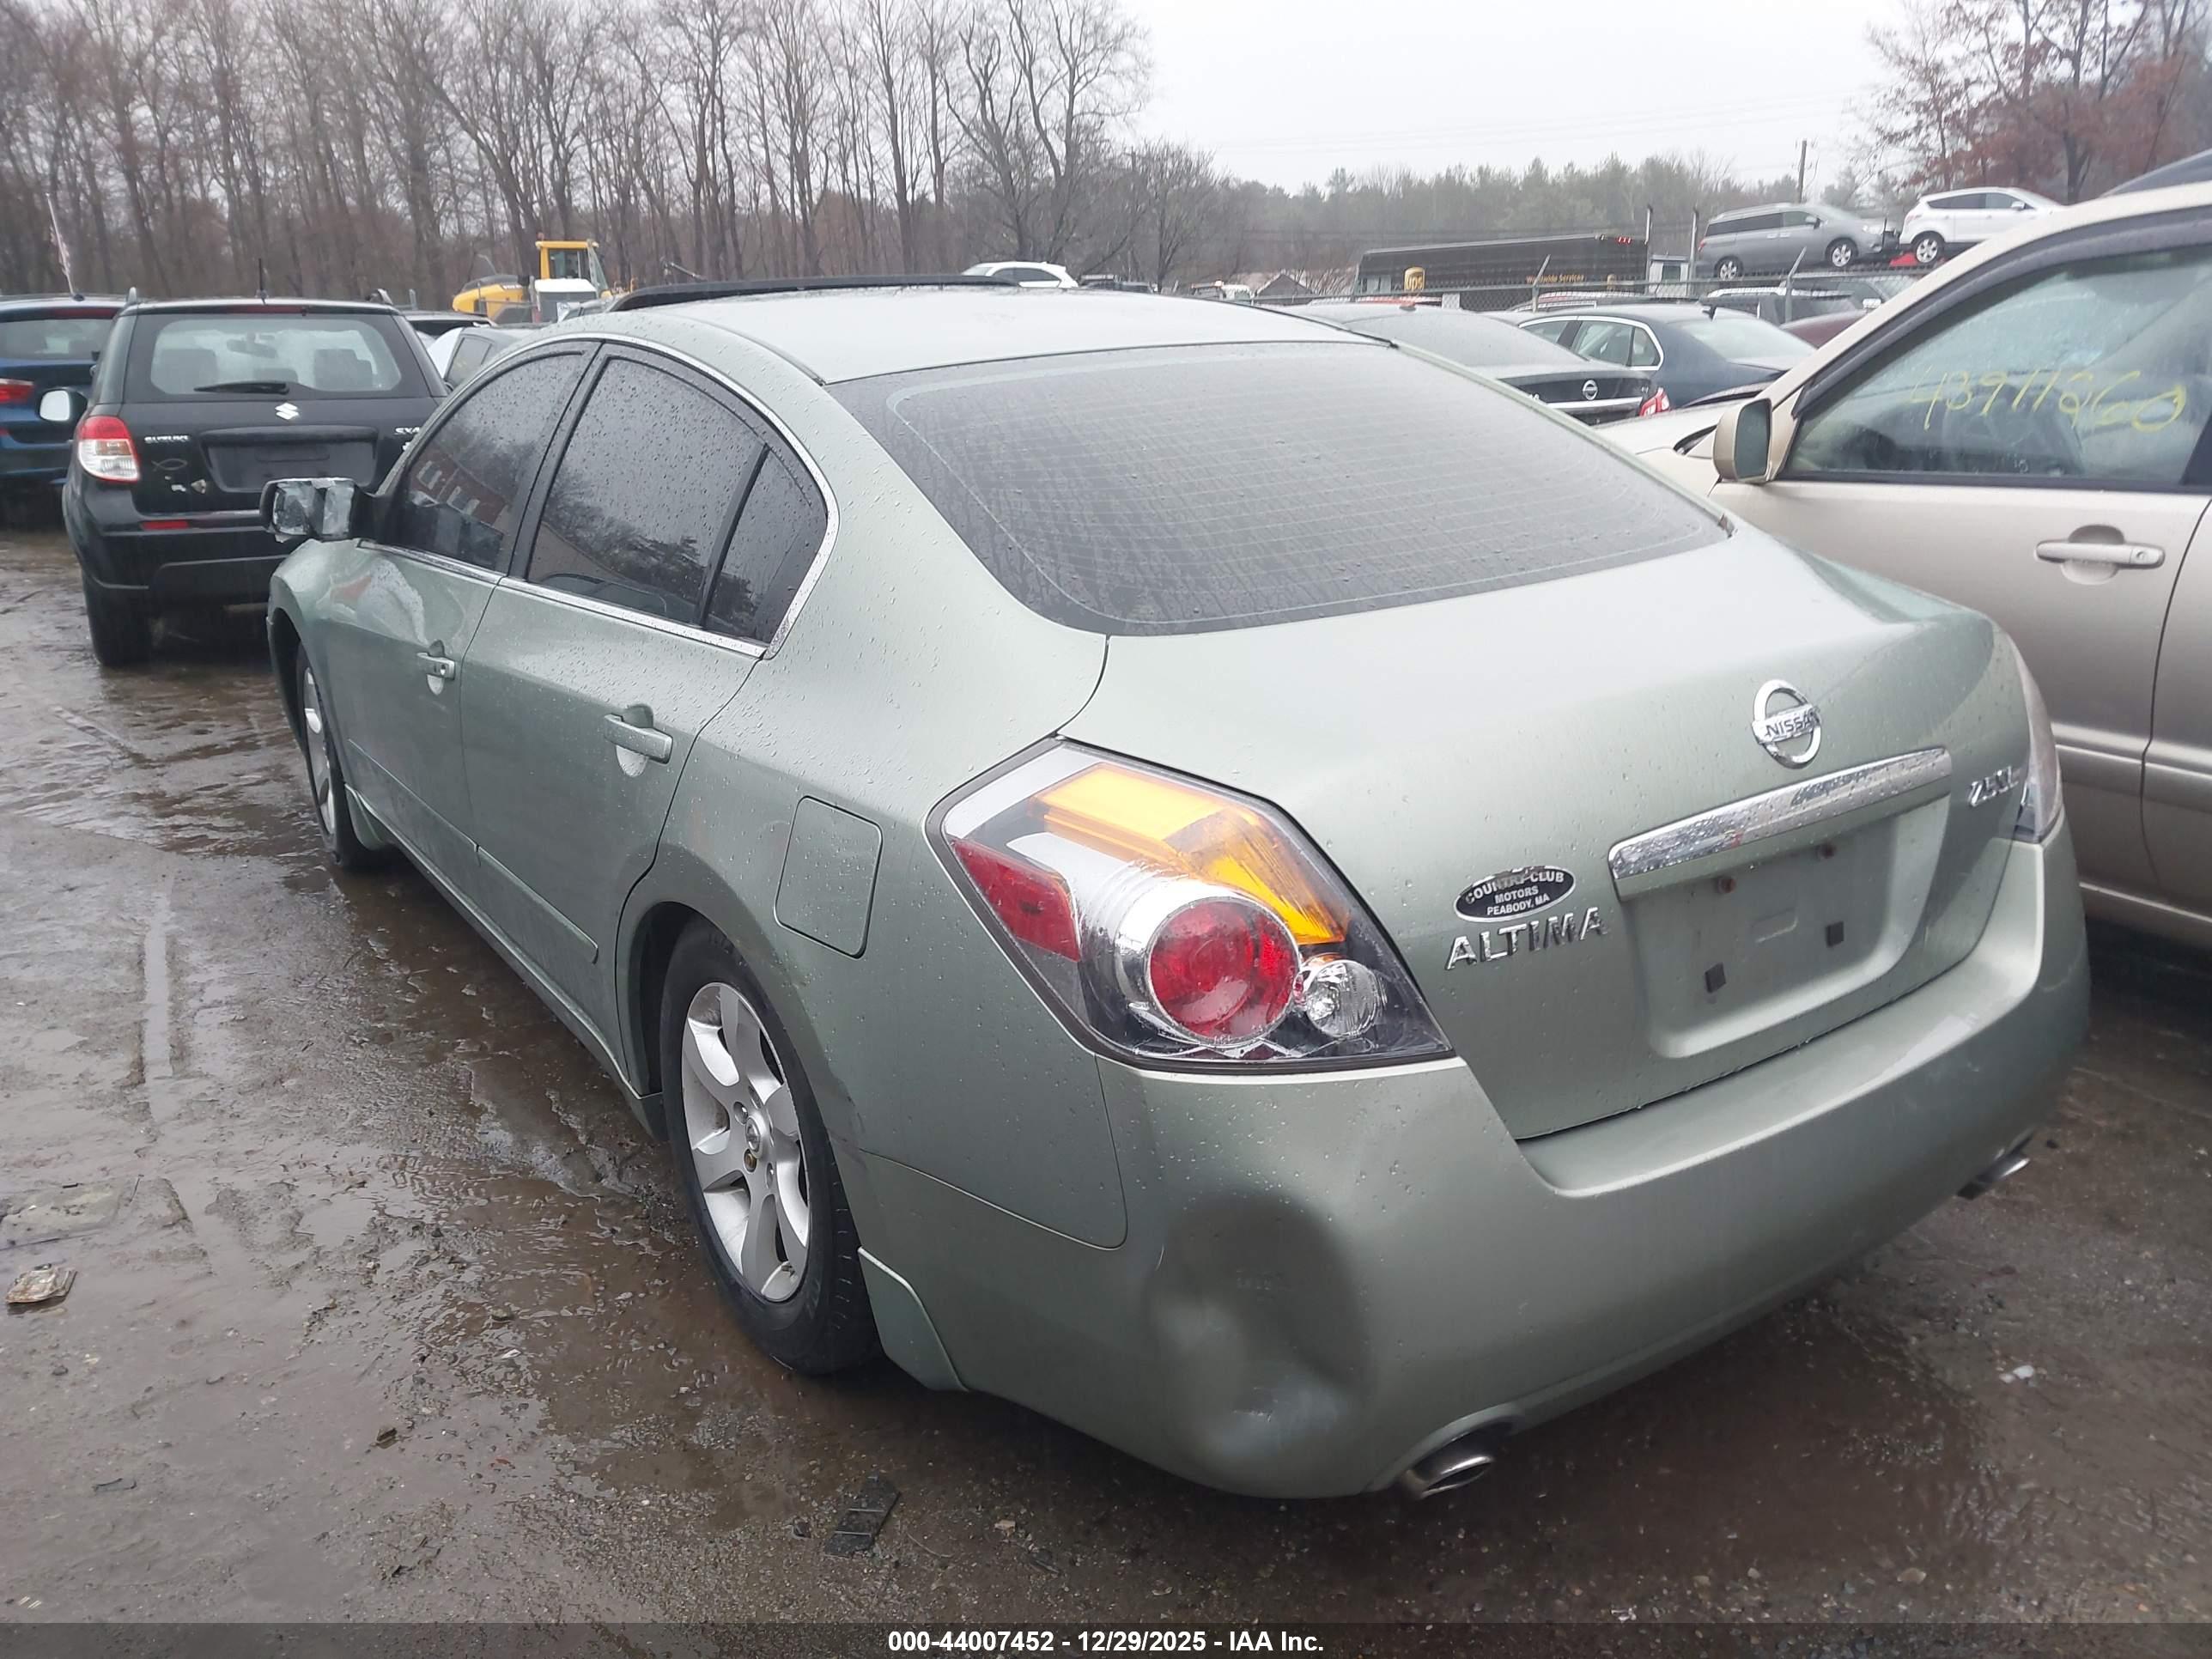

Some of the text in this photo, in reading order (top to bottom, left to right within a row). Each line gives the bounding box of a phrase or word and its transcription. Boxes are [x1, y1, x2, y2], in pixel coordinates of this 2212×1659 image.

[1529, 871, 1565, 883] CLUB
[1486, 893, 1550, 916] PEABODY, MA
[1494, 885, 1539, 904] MOTORS
[1444, 907, 1609, 970] ALTIMA
